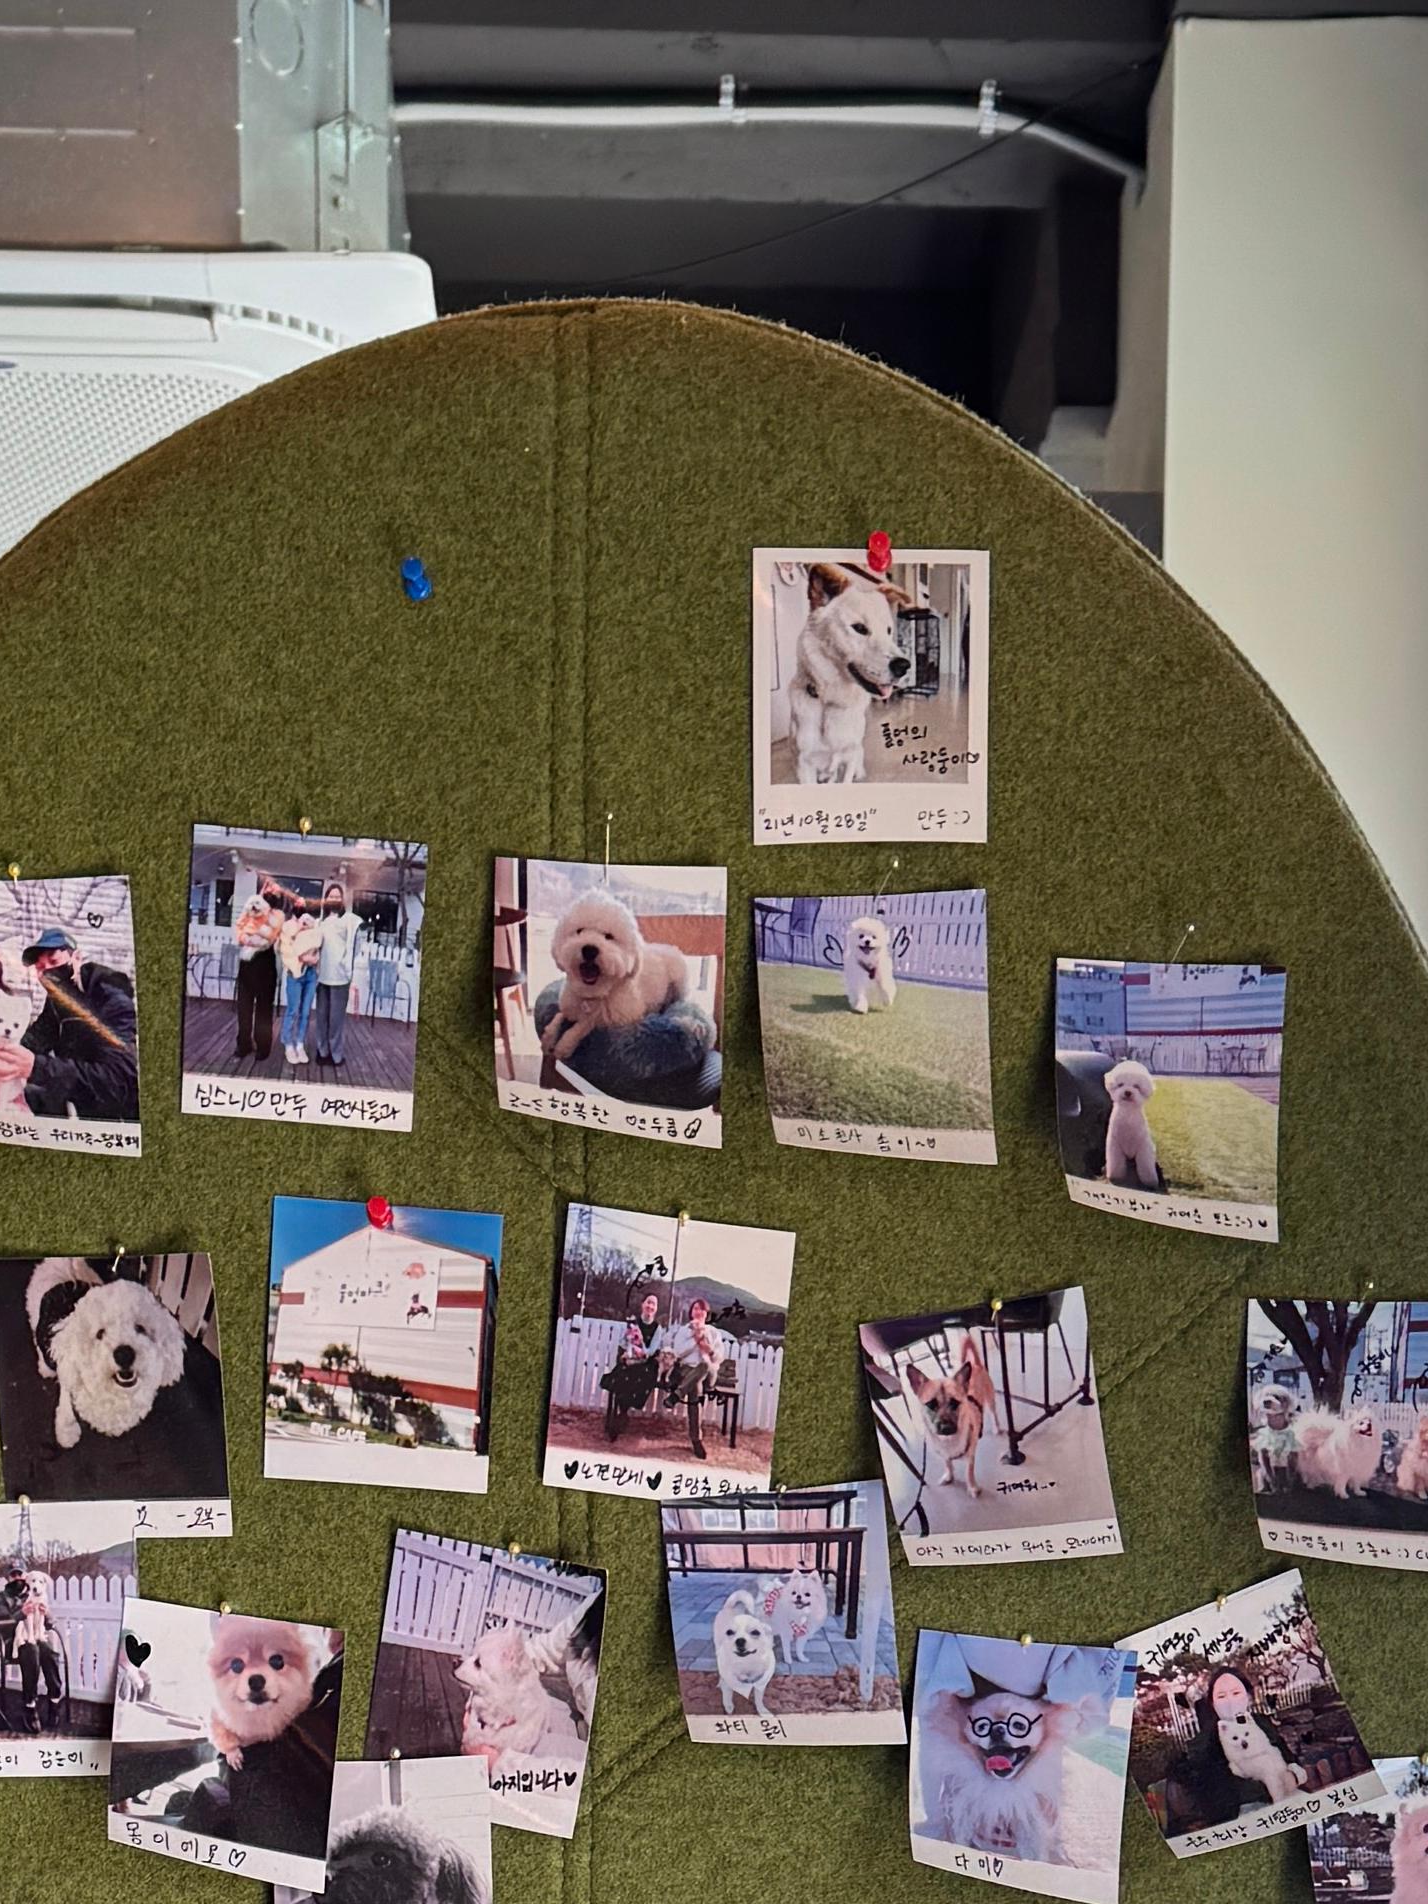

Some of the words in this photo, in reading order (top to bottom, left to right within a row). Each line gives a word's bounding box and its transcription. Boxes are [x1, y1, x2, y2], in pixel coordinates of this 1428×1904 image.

[902, 746, 965, 775] 사랑둥이
[917, 808, 948, 831] 만두
[916, 1545, 943, 1559] 아직
[952, 1542, 1012, 1556] 카메라가
[488, 1768, 563, 1797] 아지입니다
